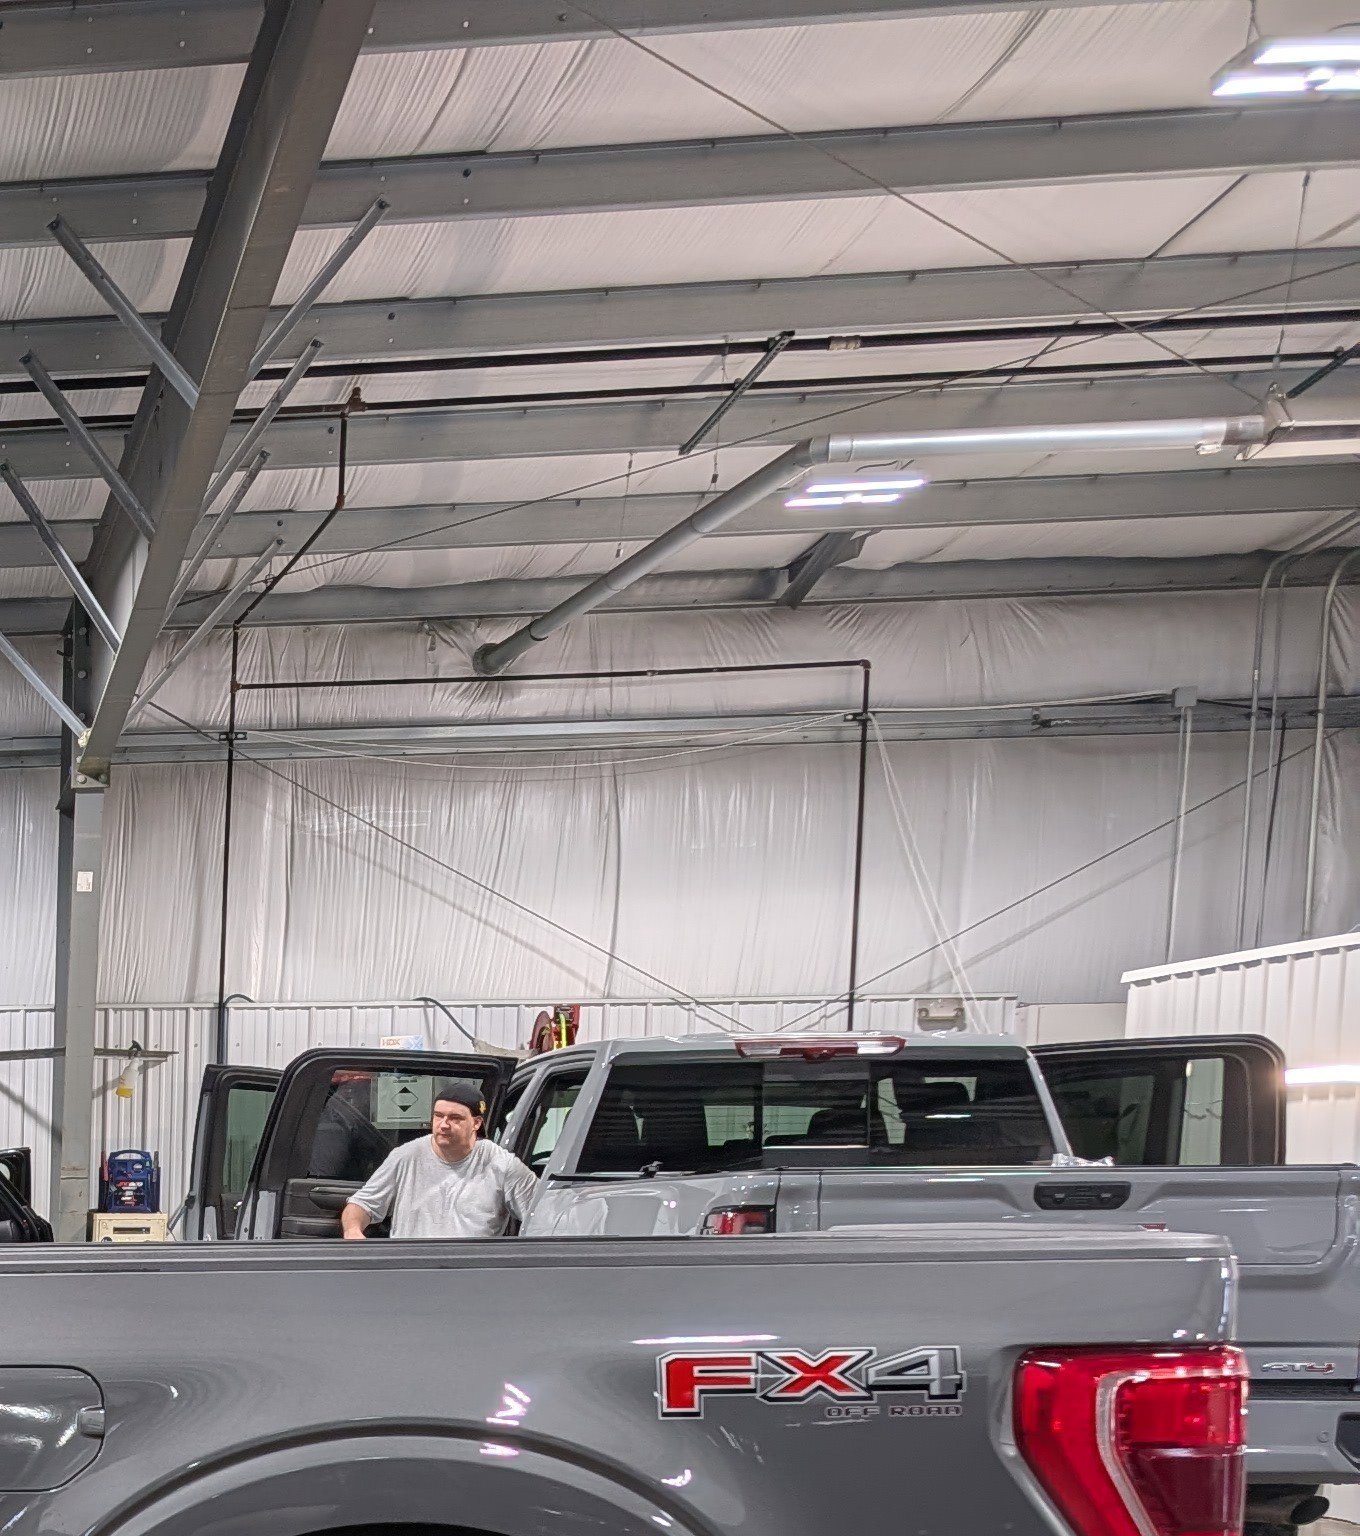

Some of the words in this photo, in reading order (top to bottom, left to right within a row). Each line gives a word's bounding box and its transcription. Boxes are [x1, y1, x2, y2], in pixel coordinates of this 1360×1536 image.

[657, 1347, 966, 1418] FX4
[827, 1406, 879, 1418] OFF
[888, 1405, 962, 1417] ROAD
